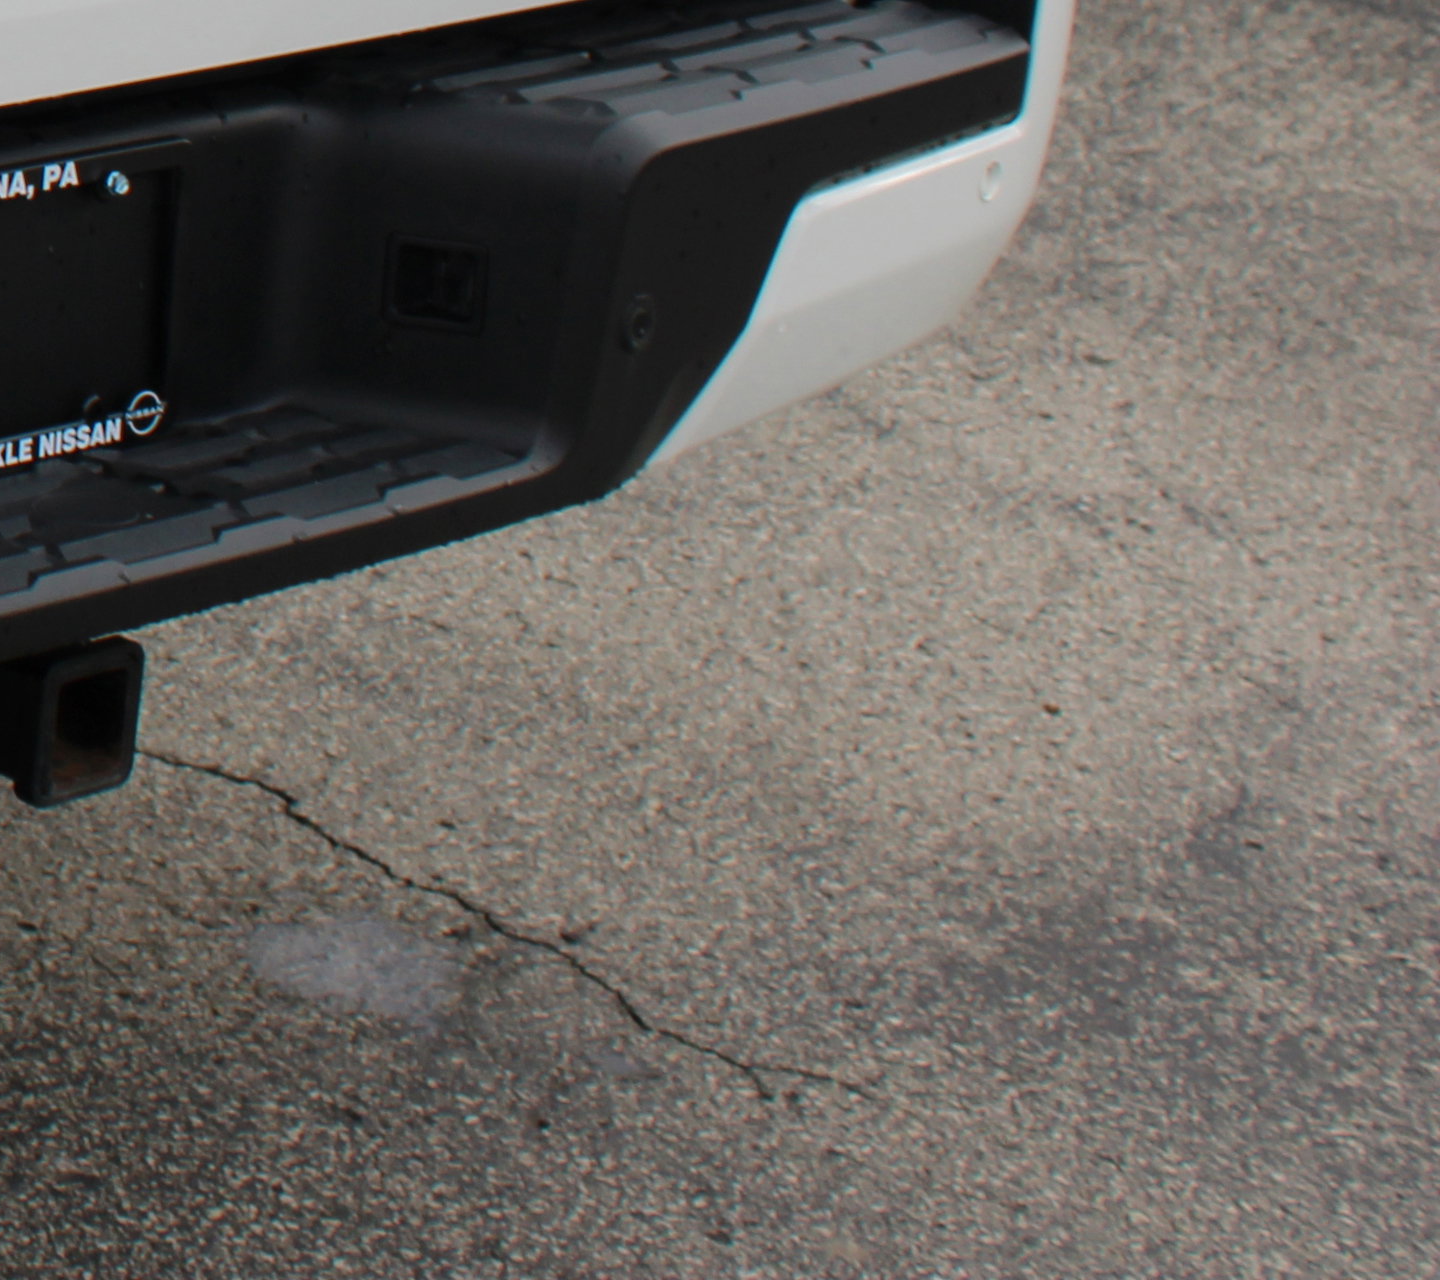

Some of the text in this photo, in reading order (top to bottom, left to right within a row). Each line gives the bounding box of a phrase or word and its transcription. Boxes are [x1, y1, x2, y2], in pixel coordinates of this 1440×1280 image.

[42, 161, 79, 192] PA
[126, 403, 165, 422] NISSAN
[38, 417, 122, 458] NISSAN
